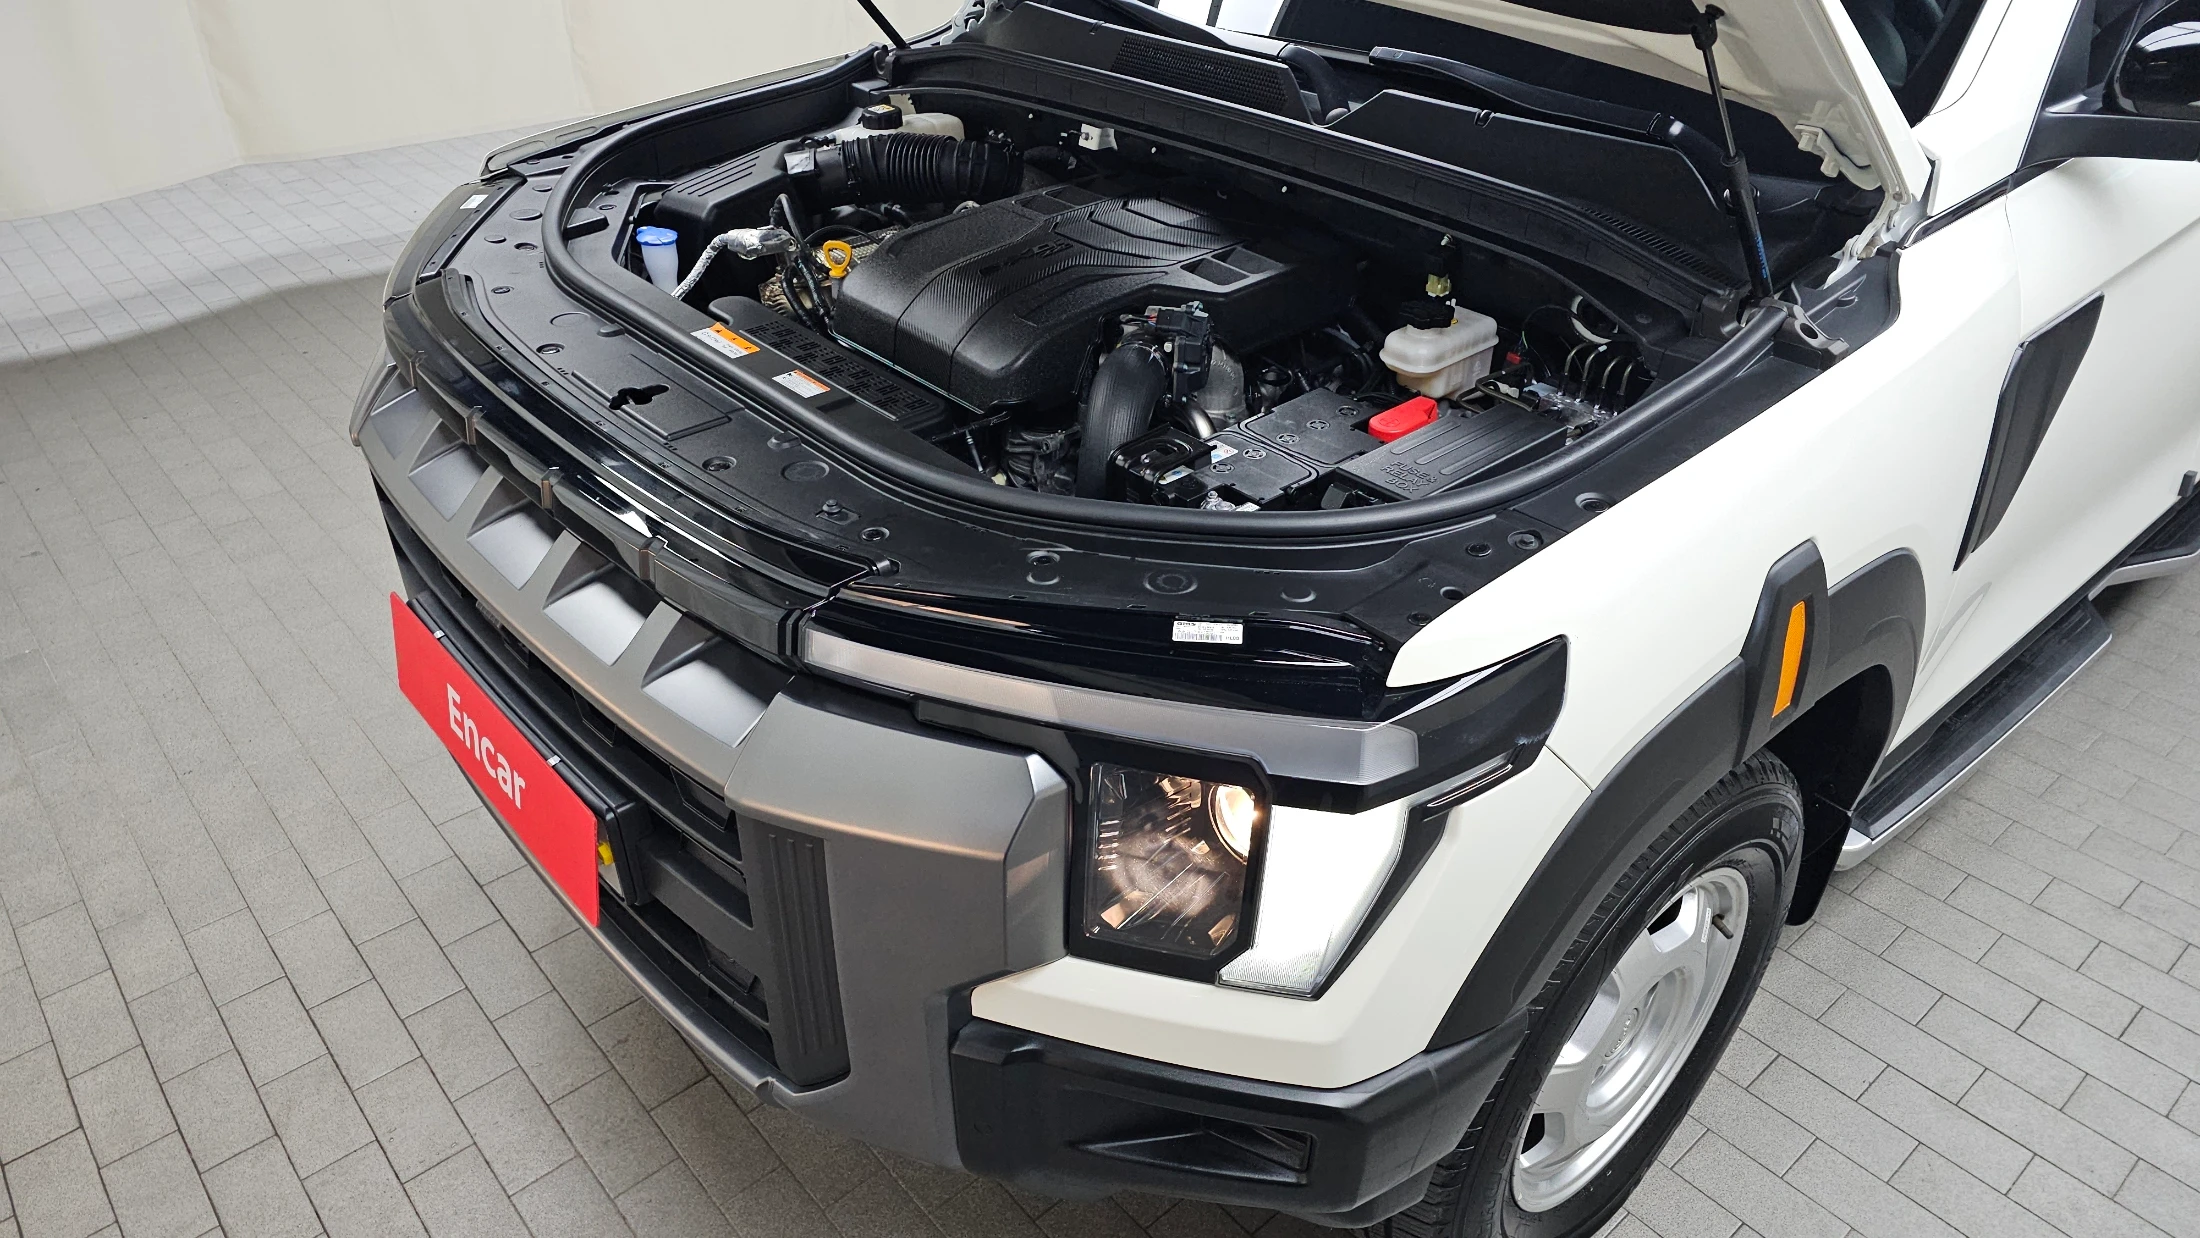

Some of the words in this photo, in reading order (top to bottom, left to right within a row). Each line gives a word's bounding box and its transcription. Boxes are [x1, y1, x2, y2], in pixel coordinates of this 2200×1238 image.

[1380, 466, 1429, 486] RELAY
[1385, 478, 1419, 493] BOX
[446, 682, 526, 810] Encar
